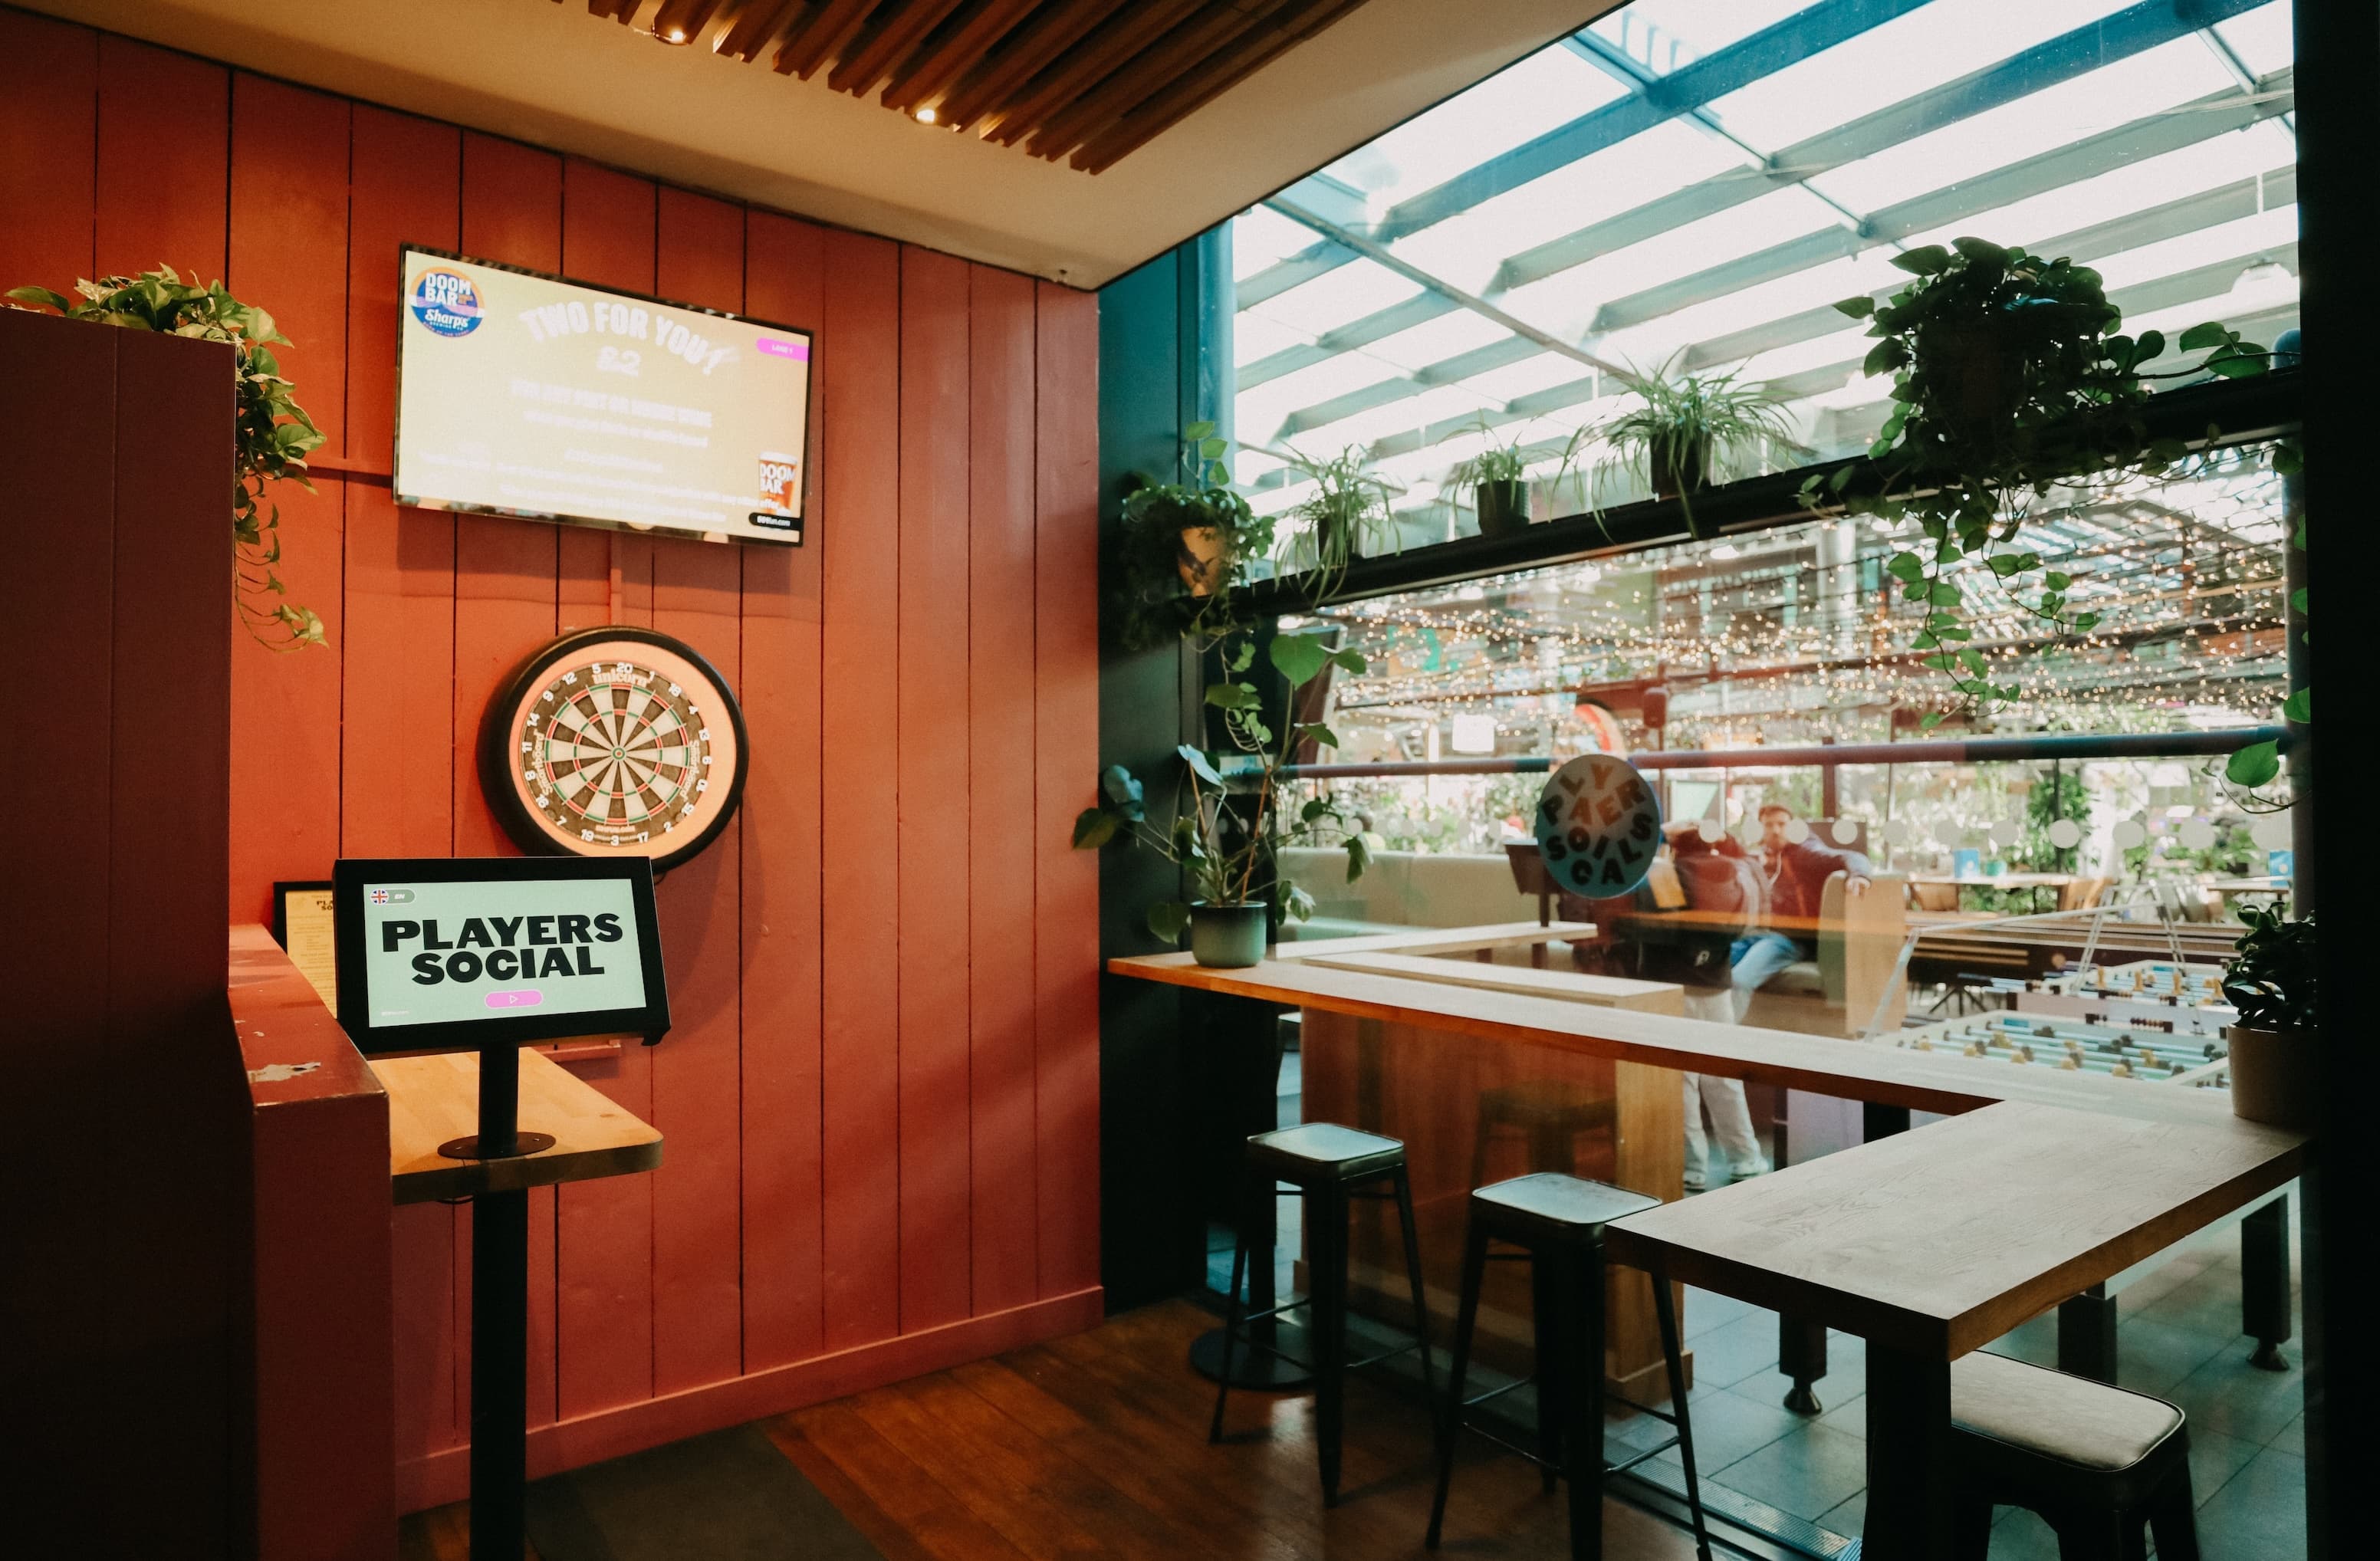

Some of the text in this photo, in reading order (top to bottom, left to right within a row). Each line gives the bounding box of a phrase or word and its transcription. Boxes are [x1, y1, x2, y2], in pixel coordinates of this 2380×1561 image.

[426, 272, 471, 294] DOOM
[425, 287, 458, 307] BAR
[519, 301, 590, 343] TWO
[593, 301, 648, 340] FOR
[760, 463, 795, 482] DOOM
[591, 663, 602, 674] 5
[616, 662, 633, 674] 20
[561, 672, 577, 685] 12
[592, 669, 650, 688] unicorn
[649, 671, 656, 681] 1
[542, 690, 554, 702] 9
[688, 705, 699, 715] 4
[527, 712, 540, 727] 14
[521, 741, 533, 753] 11
[524, 770, 537, 781] 8
[695, 778, 708, 792] 10
[536, 794, 550, 809] 16
[681, 802, 695, 816] 15
[557, 815, 567, 827] 7
[663, 821, 674, 833] 2
[580, 829, 594, 843] 19
[610, 835, 620, 846] 3
[637, 831, 649, 843] 17
[382, 913, 623, 952] PLAYERS
[411, 946, 605, 985] SOCIAL
